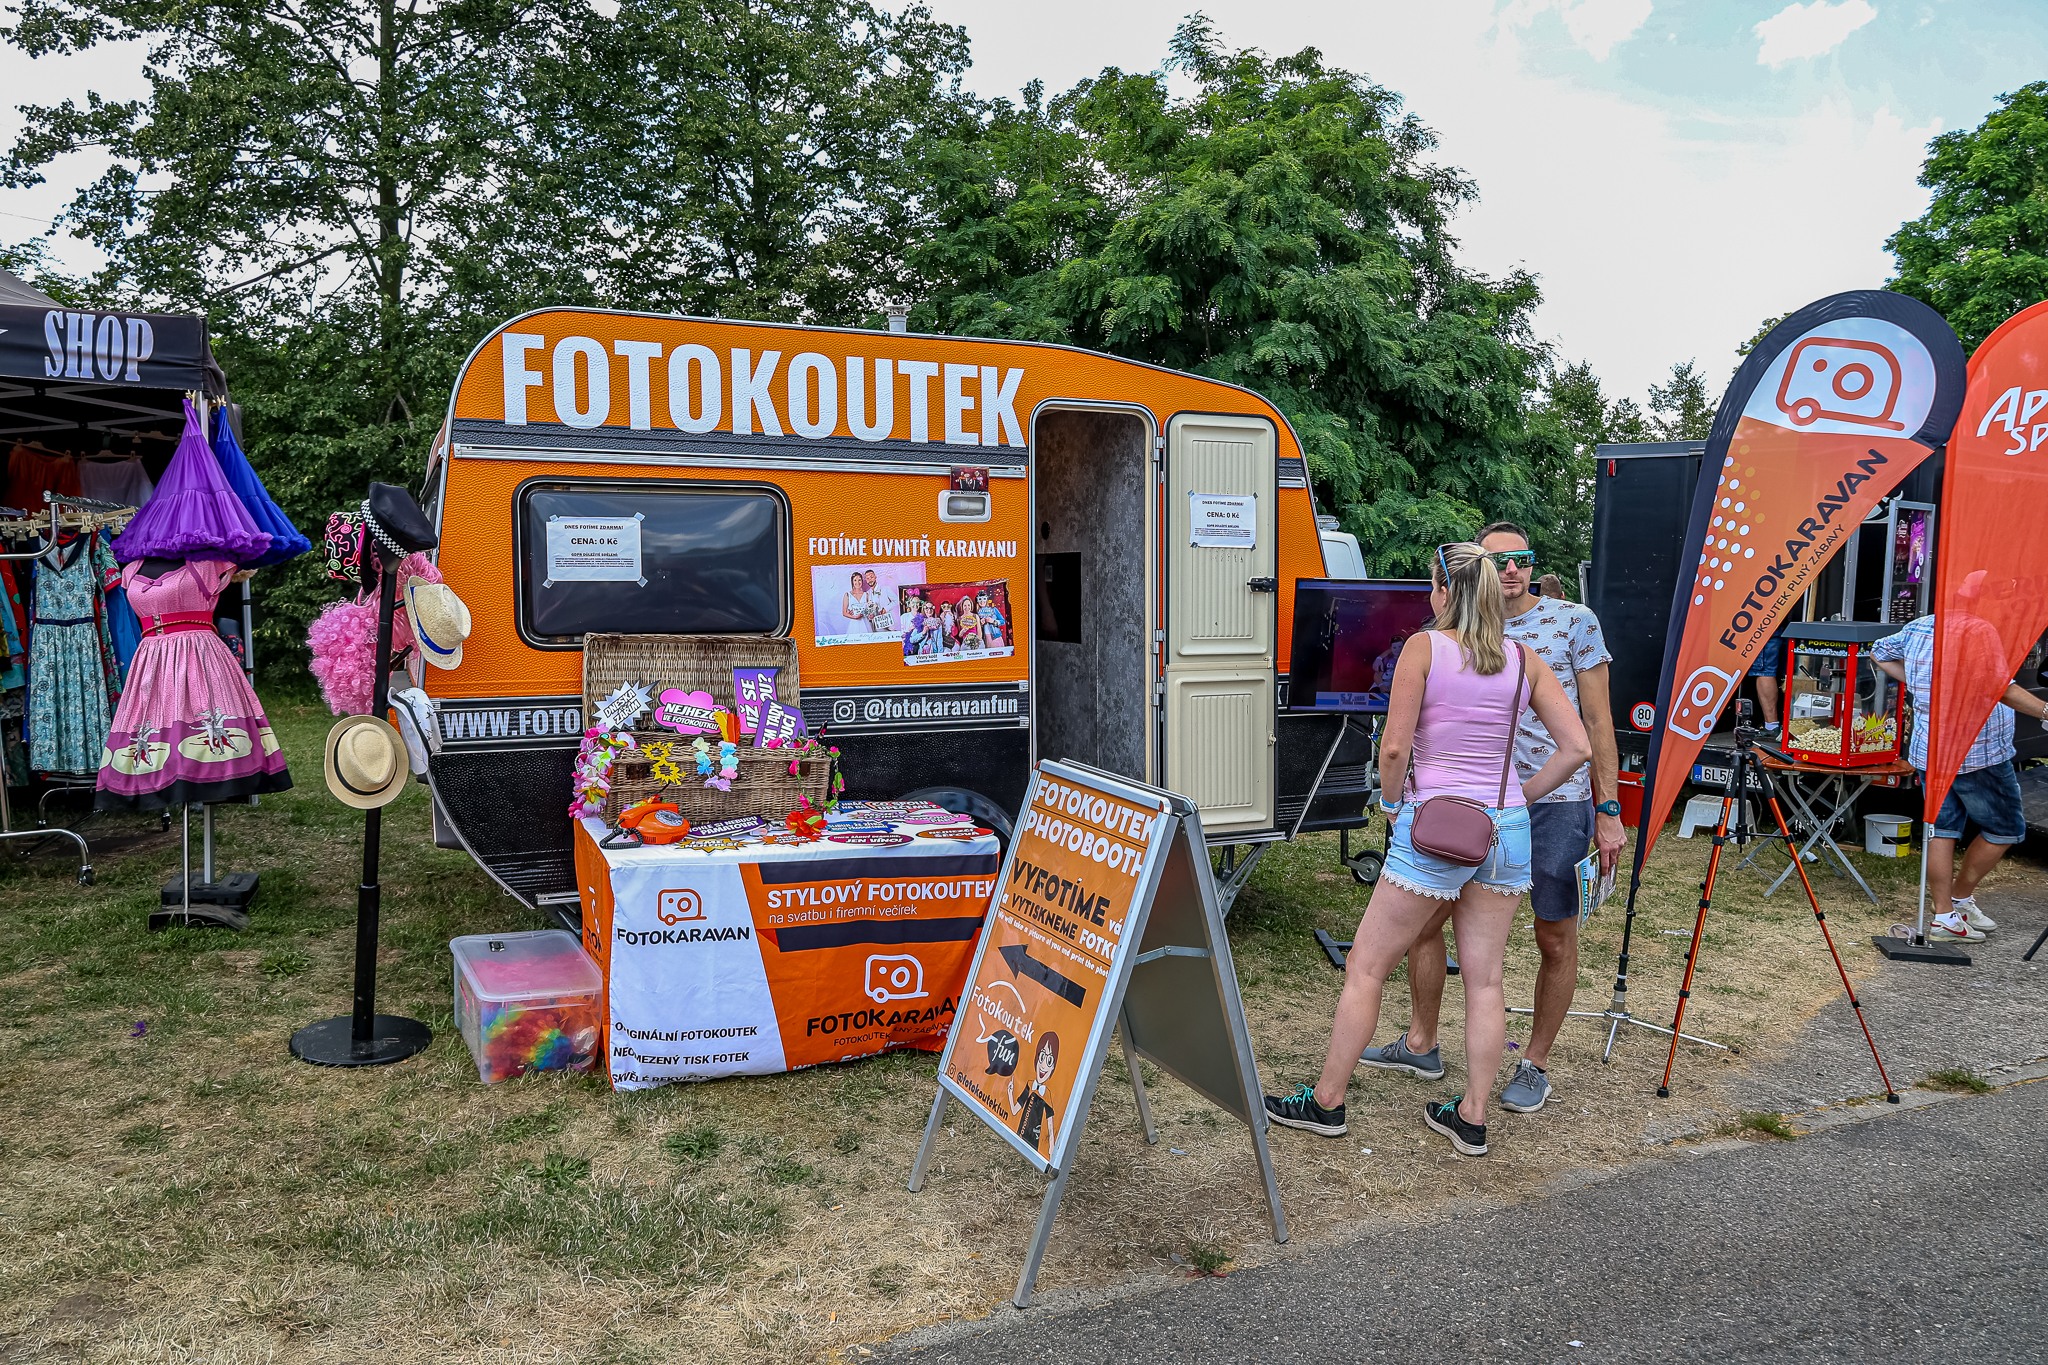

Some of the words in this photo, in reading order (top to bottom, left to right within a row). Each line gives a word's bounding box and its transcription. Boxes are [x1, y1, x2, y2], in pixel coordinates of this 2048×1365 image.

[44, 310, 154, 382] SHOP
[502, 332, 1026, 447] FOTOKOUTEK
[607, 537, 618, 545] Kč
[808, 533, 868, 557] FOTÍME
[872, 534, 931, 557] UVNITŘ
[936, 539, 1017, 558] KARAVANU
[1719, 449, 1889, 651] FOTOKARAVAN
[1741, 591, 1792, 658] FOTOKOUTEK
[1787, 563, 1812, 592] PLNÝ
[1808, 523, 1845, 565] ZÁBAVY
[1808, 640, 1847, 648] POPCORN
[603, 688, 637, 718] DNESKA
[741, 678, 757, 702] SE
[766, 702, 784, 727] TADY
[864, 694, 1018, 722] @fotokaravanfun
[1637, 708, 1651, 720] 80
[443, 708, 586, 739] WWW.FOTO
[673, 716, 720, 731] FOTOKOUTKU!
[1033, 778, 1158, 842] FOTOKOUTEK
[700, 821, 760, 836] PAMATOVAT
[1023, 809, 1143, 878] PHOTOBOOTH
[768, 880, 863, 908] STYLOVÝ
[868, 880, 996, 901] FOTOKOUTEK
[1013, 856, 1111, 928] VYFOTÍME
[769, 913, 784, 924] na
[787, 907, 826, 923] svatbu
[829, 907, 834, 919] i
[836, 904, 876, 919] firemní
[878, 903, 918, 918] večírek
[1002, 892, 1010, 905] a
[1011, 892, 1079, 940] VYTISKNEME
[616, 927, 750, 947] FOTOKARAVAN
[1004, 915, 1013, 925] will
[1013, 919, 1024, 931] take
[1028, 928, 1046, 944] picture
[1050, 941, 1062, 952] you
[1061, 946, 1072, 957] and
[1070, 952, 1085, 965] print
[1085, 959, 1095, 971] the
[970, 985, 1034, 1044] Fotokoutek
[614, 1021, 678, 1042] OIGINÁLNÍ
[680, 1026, 758, 1042] FOTOKOUTEK
[833, 1031, 892, 1047] FOTOKOUTEK
[683, 1054, 710, 1065] TISK
[712, 1051, 750, 1064] FOTEK
[992, 1034, 1016, 1066] fun
[956, 1071, 1009, 1122] @fotokoutekfun
